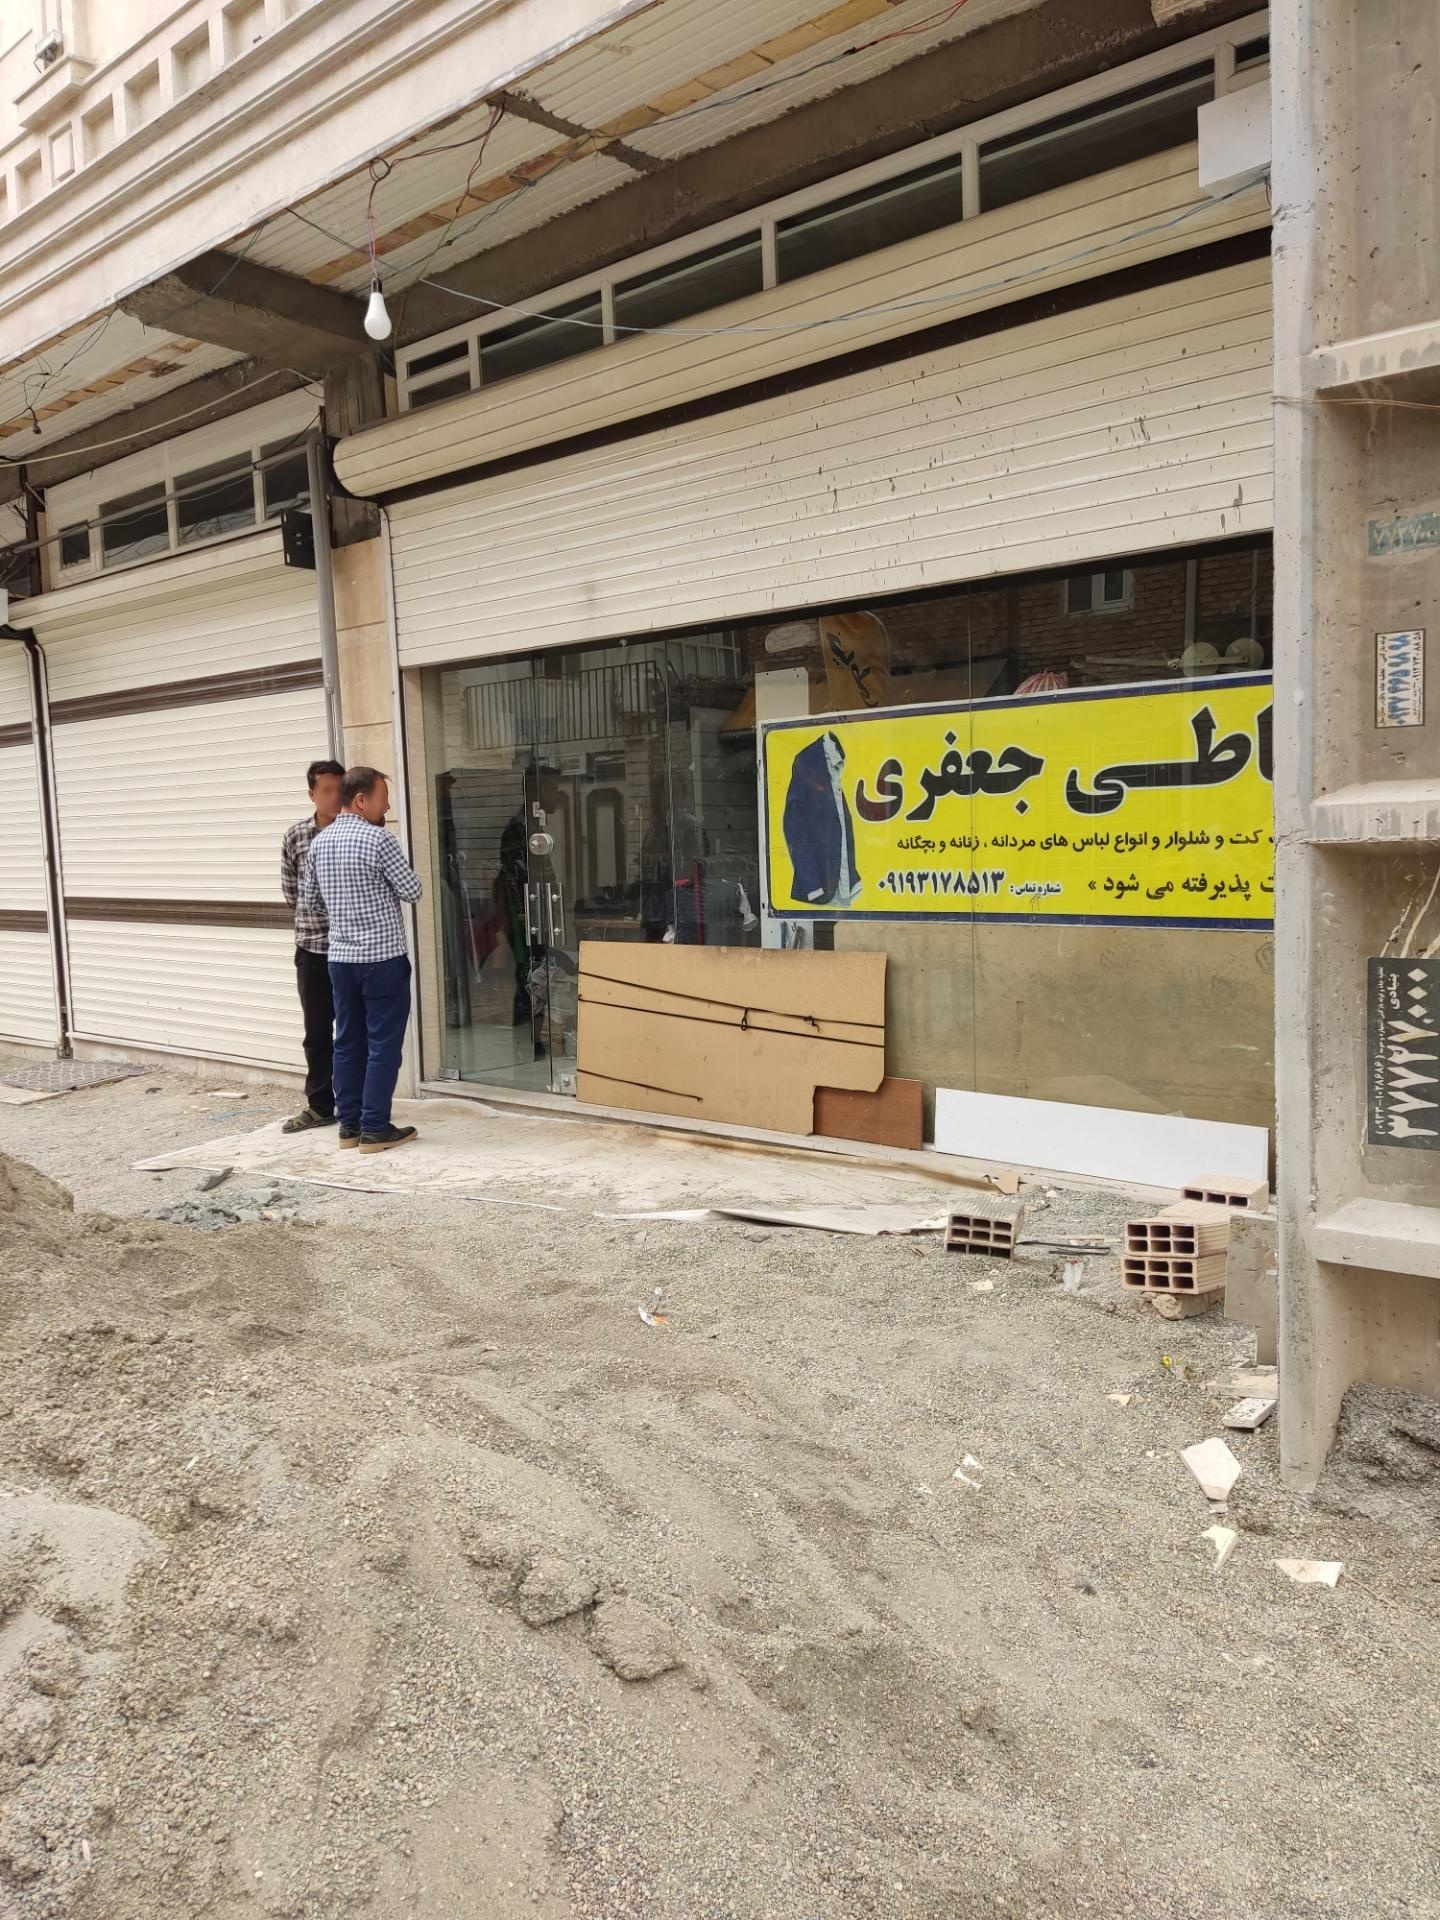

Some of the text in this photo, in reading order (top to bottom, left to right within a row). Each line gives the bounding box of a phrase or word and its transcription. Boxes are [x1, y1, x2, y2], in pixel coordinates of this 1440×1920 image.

[855, 729, 1044, 823] جعفری
[897, 835, 936, 854] بچگانه
[949, 836, 980, 851] زنانه
[991, 834, 1036, 852] مردانه
[1040, 833, 1068, 851] های
[1072, 832, 1110, 853] لباس
[1113, 832, 1148, 853] انواع
[1151, 834, 1161, 850] و
[1164, 830, 1210, 851] شلوار
[1214, 834, 1224, 850] و
[1229, 829, 1263, 844] کت
[939, 842, 946, 853] و
[878, 871, 1005, 894] ۰۹۱۹۳۱۷۸۵۱۳
[1037, 883, 1062, 896] شماره
[1146, 880, 1174, 899] می
[1182, 873, 1250, 901] پذیرفته
